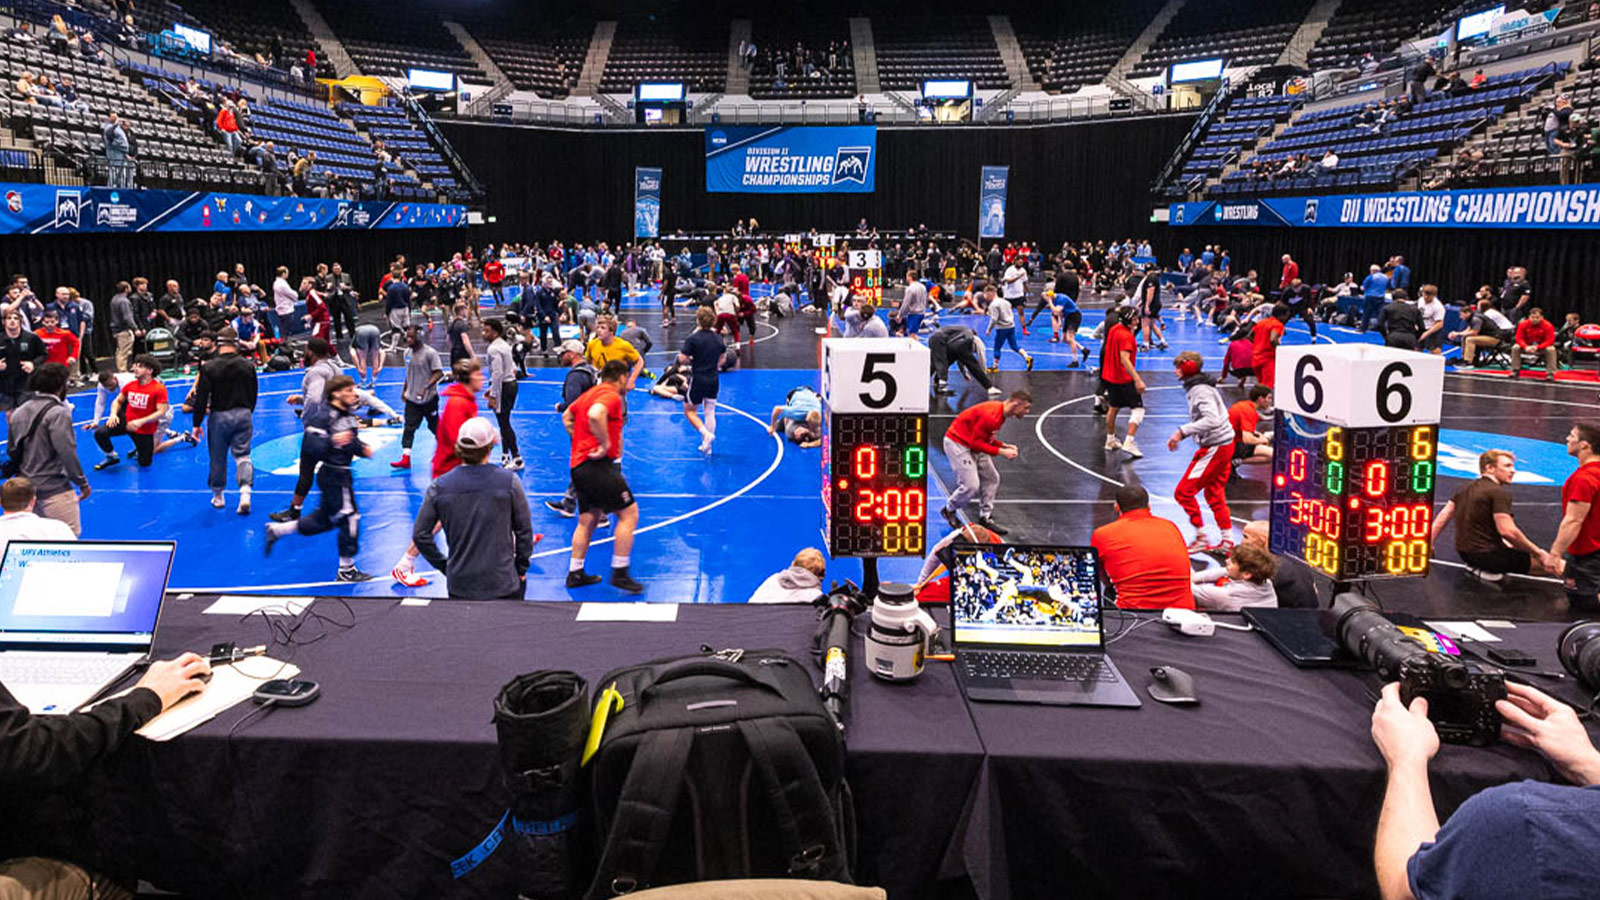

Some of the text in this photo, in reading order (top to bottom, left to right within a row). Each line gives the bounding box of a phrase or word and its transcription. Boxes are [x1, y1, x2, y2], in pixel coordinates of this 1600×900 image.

[745, 156, 834, 173] WRESTLING
[781, 147, 789, 155] II
[742, 174, 830, 185] CHAMPIONSHIPS
[1223, 204, 1259, 220] WRESTLING
[1340, 199, 1359, 223] DII
[1363, 195, 1451, 223] WRESTLING
[856, 252, 867, 267] 3
[858, 353, 897, 409] 5
[1294, 354, 1412, 423] 6 6
[915, 418, 922, 444] 1
[1326, 427, 1343, 460] 6
[1412, 427, 1431, 459] 6
[856, 447, 924, 478] 0 0
[1290, 448, 1343, 494] 0 0
[1366, 461, 1432, 496] 0 0
[856, 489, 923, 521] 2:00
[1289, 491, 1341, 540] 3:00
[883, 522, 923, 553] 00
[1366, 505, 1429, 541] 3:00
[37, 548, 71, 558] Athletics
[1305, 532, 1339, 574] 00
[1387, 540, 1427, 573] 00
